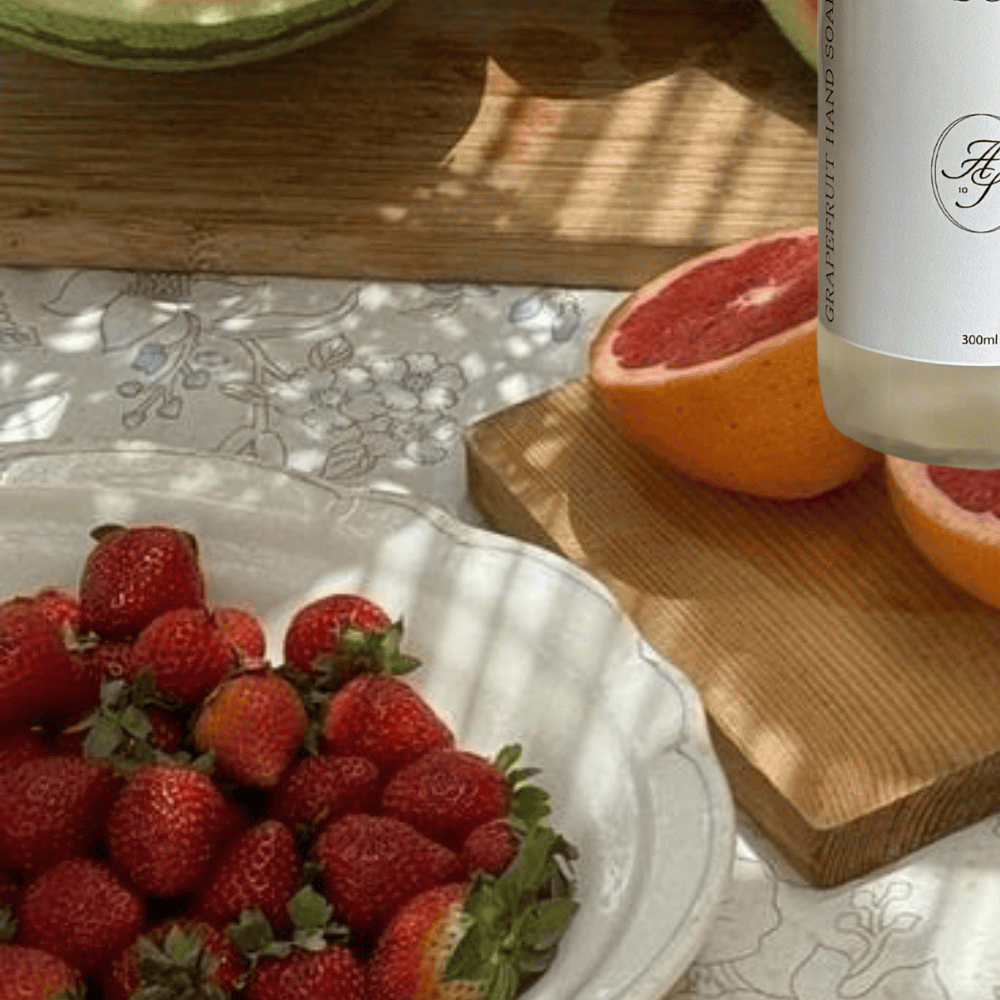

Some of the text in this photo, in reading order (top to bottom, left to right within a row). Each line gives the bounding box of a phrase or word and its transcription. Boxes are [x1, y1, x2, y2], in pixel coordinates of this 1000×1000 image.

[825, 68, 835, 145] HAND
[825, 152, 835, 323] GRAPEFRUIT
[961, 333, 998, 345] 300ml
